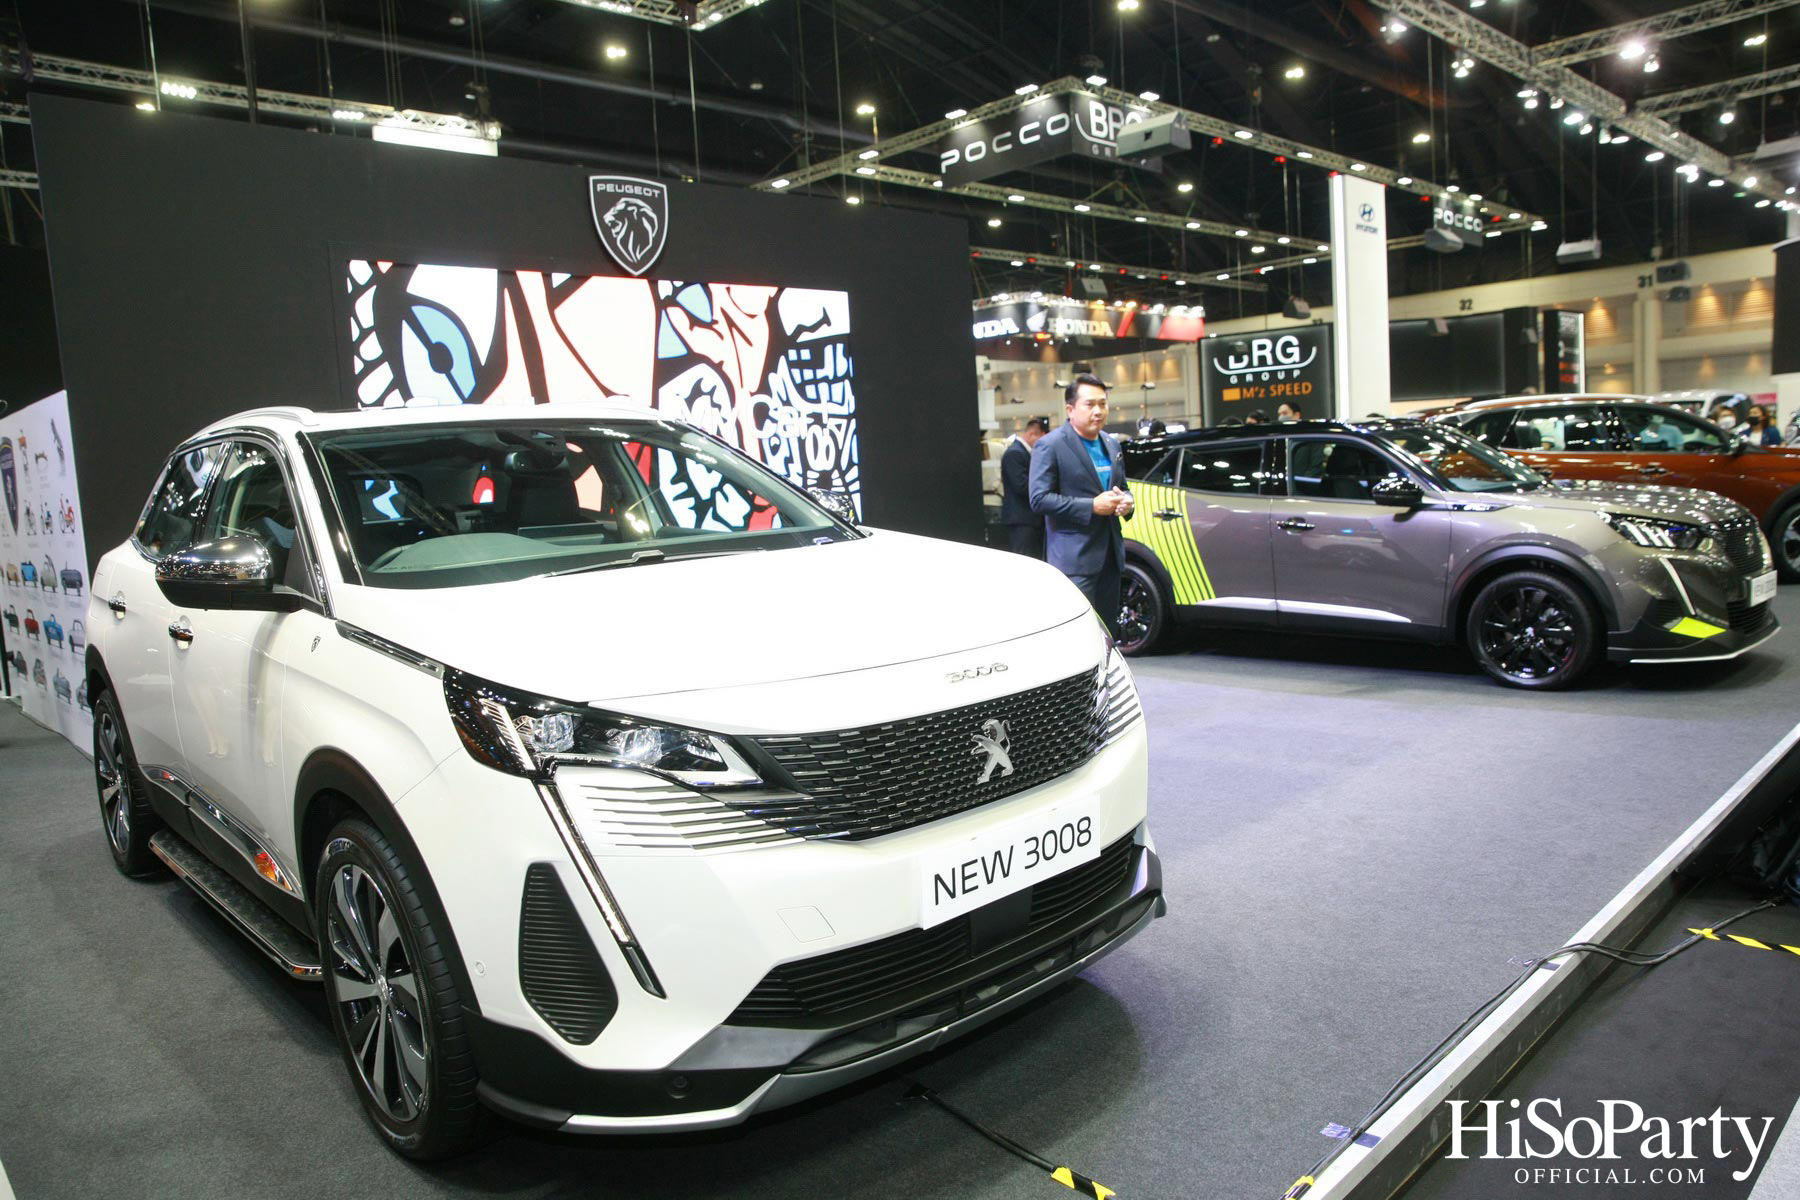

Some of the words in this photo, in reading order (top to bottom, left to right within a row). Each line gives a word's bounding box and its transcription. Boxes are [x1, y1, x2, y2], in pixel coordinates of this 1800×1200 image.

[940, 112, 1070, 174] POCCO
[597, 183, 661, 198] PEUGEOT
[1433, 207, 1483, 233] POCCO
[1637, 274, 1653, 288] 31
[1047, 318, 1115, 337] HONDA
[1229, 369, 1301, 385] GROUP
[1269, 381, 1313, 397] SPEED
[933, 845, 1014, 906] NEW
[1024, 816, 1092, 870] 3008
